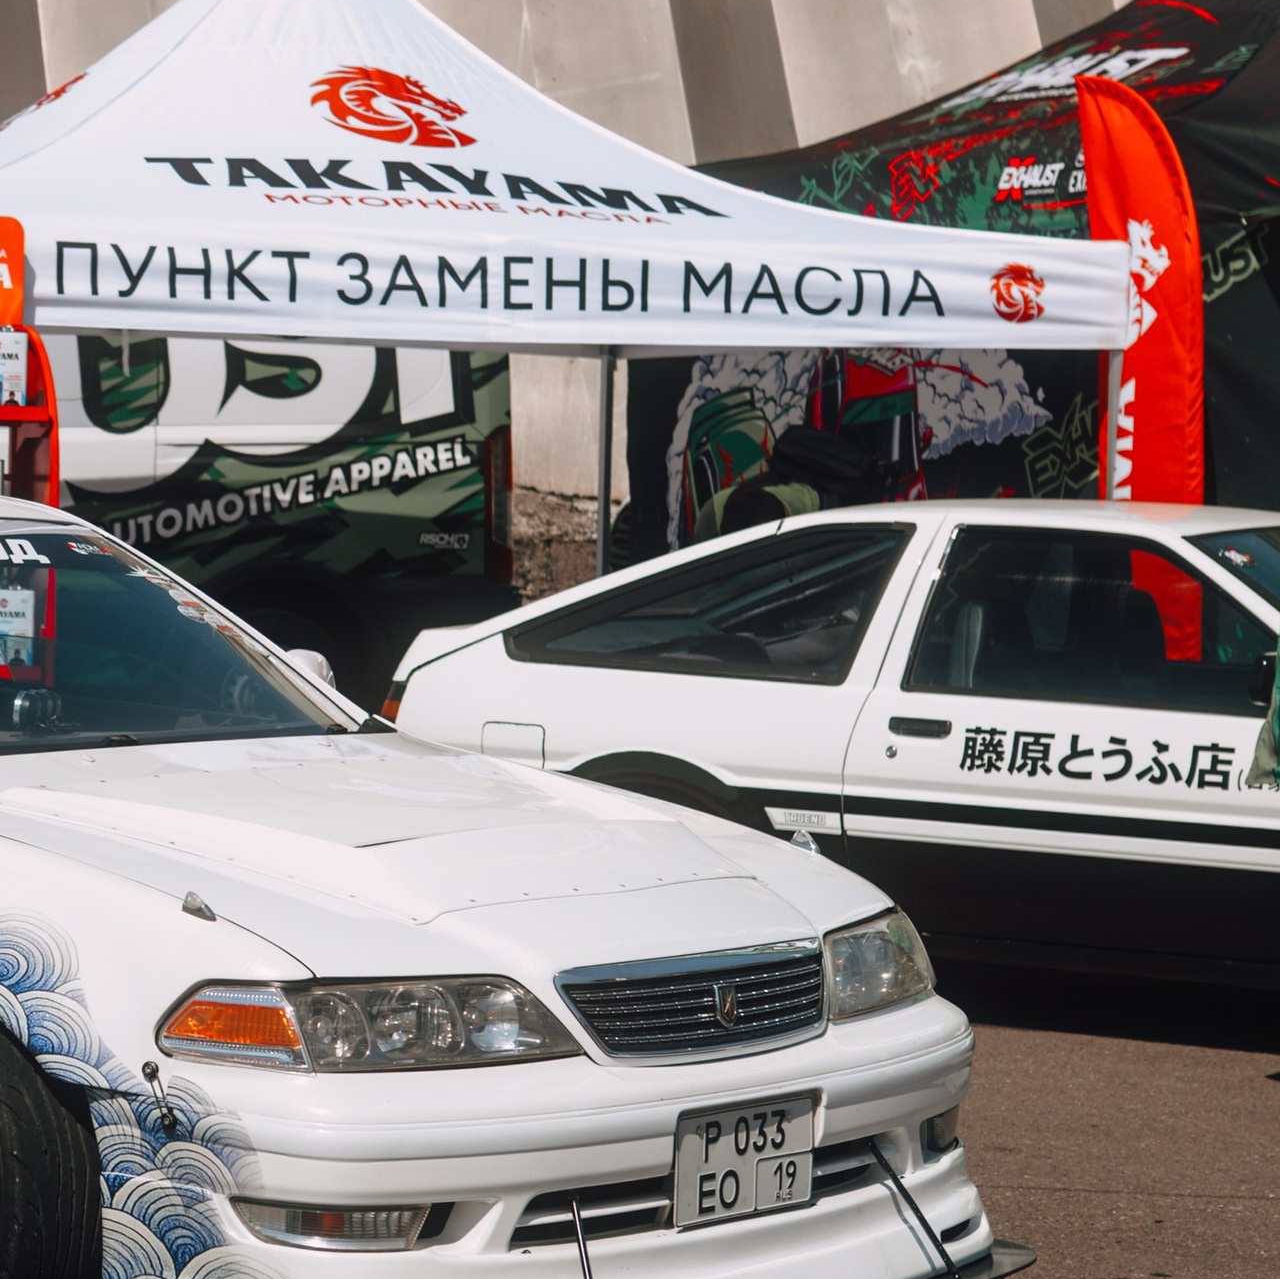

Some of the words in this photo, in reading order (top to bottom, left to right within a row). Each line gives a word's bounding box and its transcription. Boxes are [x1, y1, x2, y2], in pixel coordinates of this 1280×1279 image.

[144, 156, 733, 218] TAKAYAMA
[998, 163, 1065, 191] EXHAUST
[264, 193, 508, 214] МОТОРНЫЕ
[516, 204, 673, 225] МАСЛА
[55, 240, 311, 303] ПУНКТ
[336, 252, 650, 312] ЗАМЕНЫ
[683, 260, 946, 317] МАСЛА
[110, 472, 317, 546] UTOMOTIVE
[322, 439, 472, 499] APPAREL
[960, 726, 1236, 791] 藤原とうふ店
[783, 811, 827, 826] TRUENO
[733, 1108, 786, 1157] 033
[773, 1159, 797, 1191] 19
[775, 1189, 793, 1202] RUS
